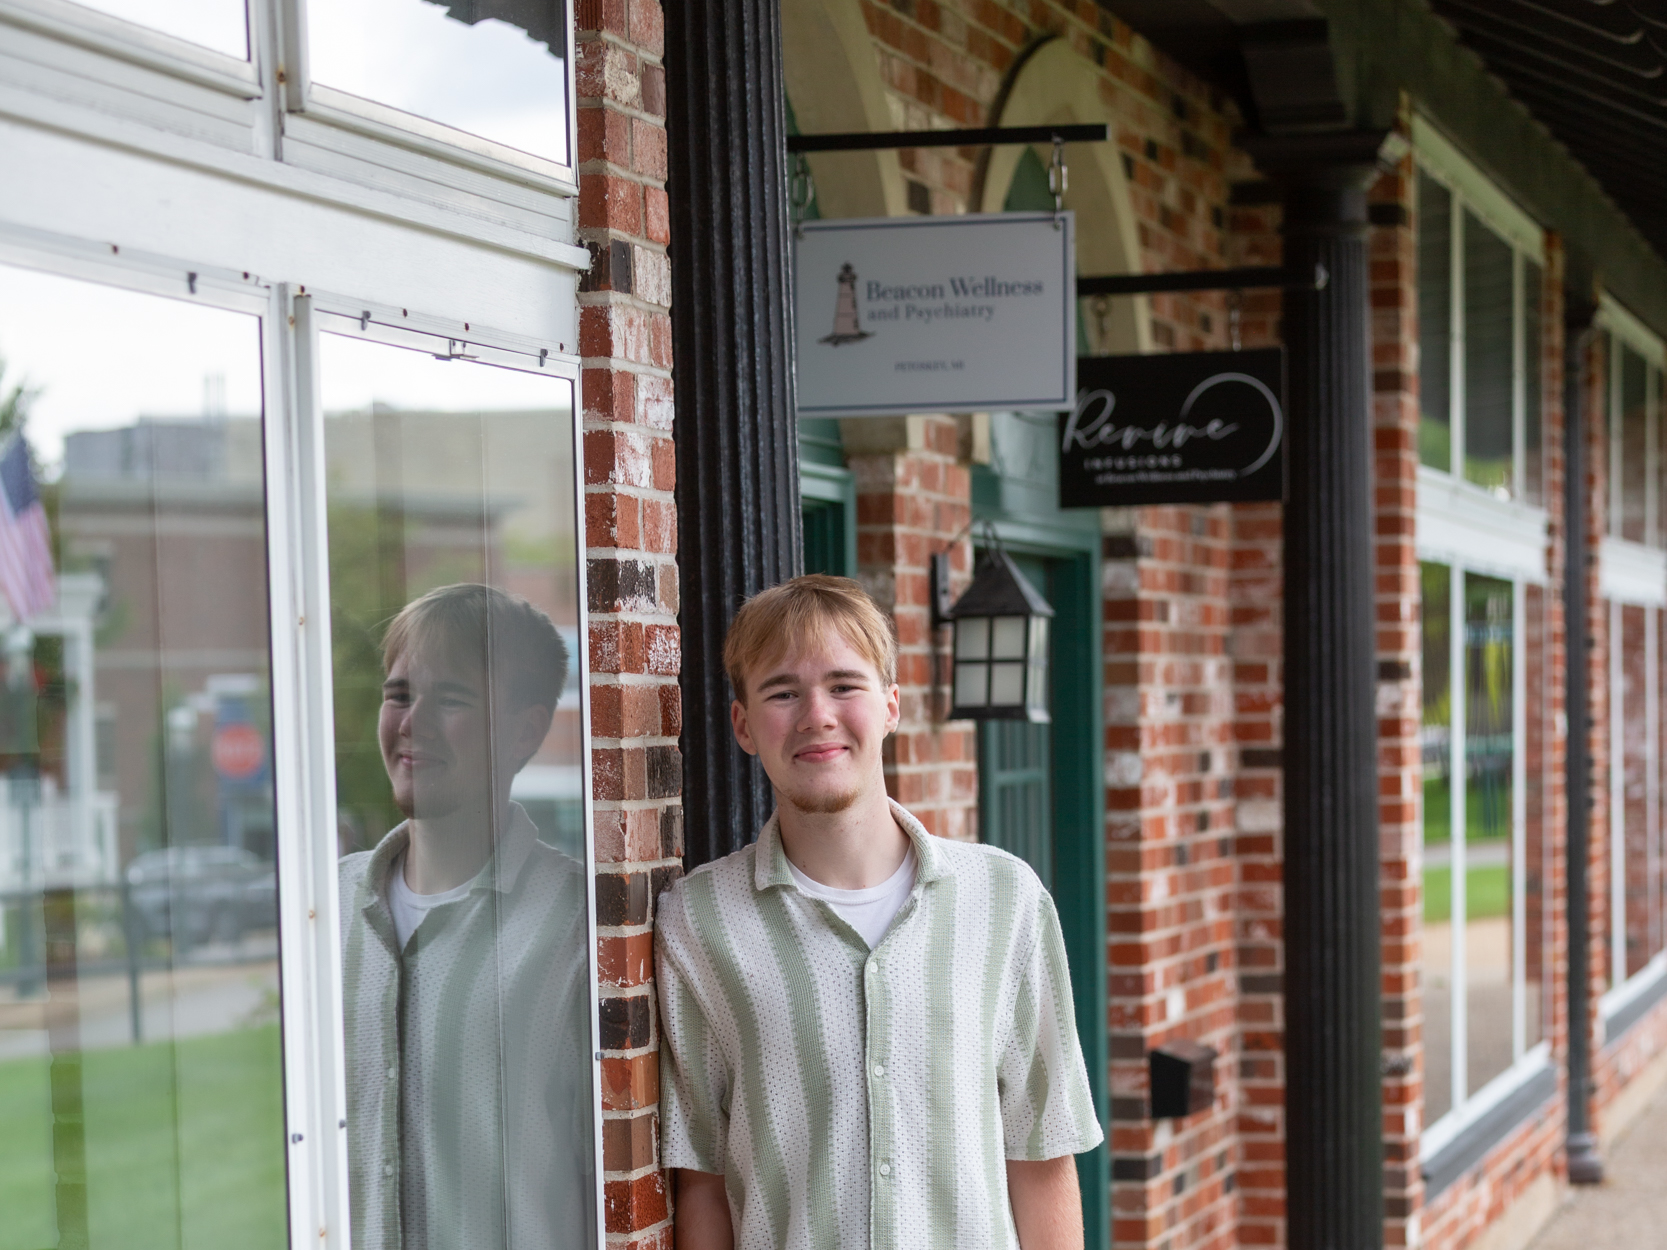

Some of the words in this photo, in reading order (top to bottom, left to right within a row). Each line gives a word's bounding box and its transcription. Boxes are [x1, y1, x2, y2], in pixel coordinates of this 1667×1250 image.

[866, 279, 945, 302] Beacon
[950, 275, 1044, 299] Wellness
[867, 304, 900, 321] and
[905, 302, 995, 324] Psychiatry
[1062, 387, 1241, 454] Revive
